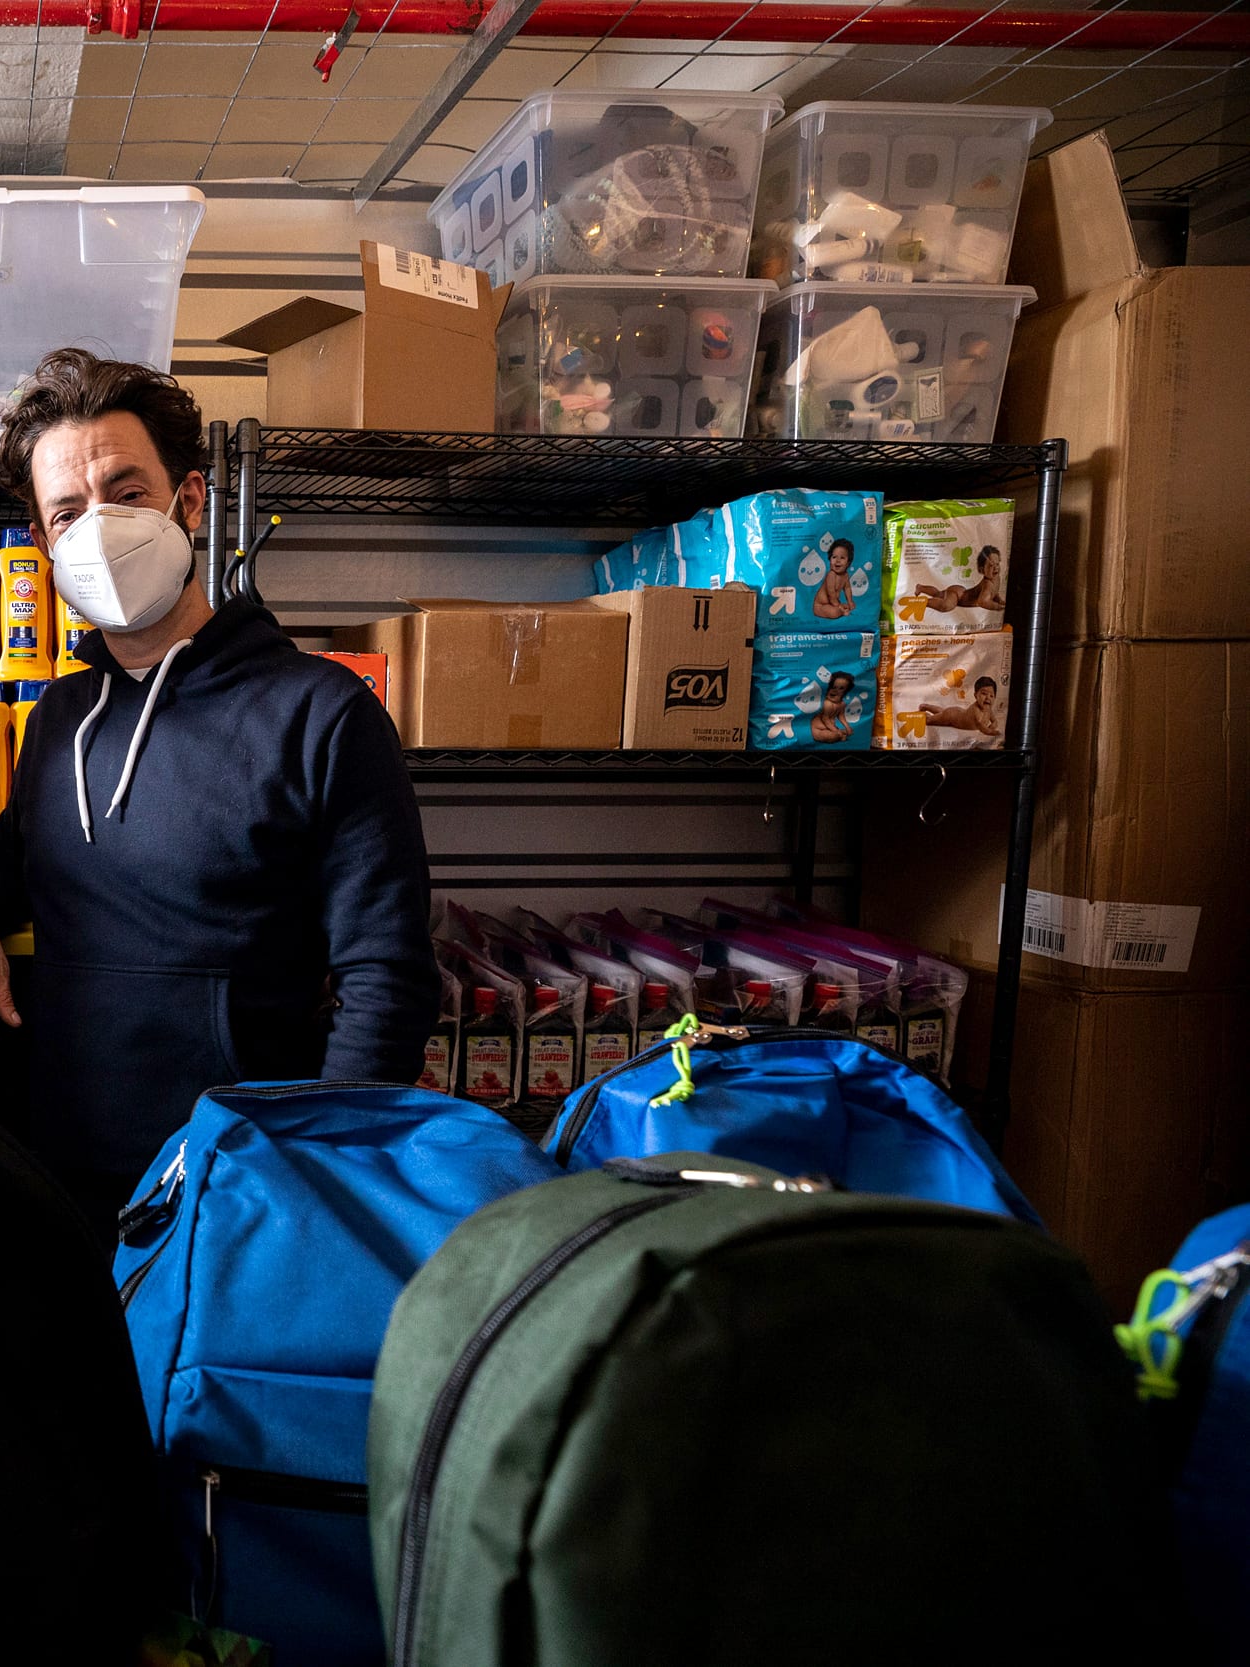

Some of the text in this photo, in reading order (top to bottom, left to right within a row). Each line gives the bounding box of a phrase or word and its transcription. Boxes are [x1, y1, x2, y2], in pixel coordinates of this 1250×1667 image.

[902, 638, 941, 647] peaches
[880, 640, 890, 676] peaches
[668, 674, 724, 699] VO5
[878, 687, 888, 714] honey
[732, 728, 743, 742] 12
[912, 1037, 940, 1045] GRAPE
